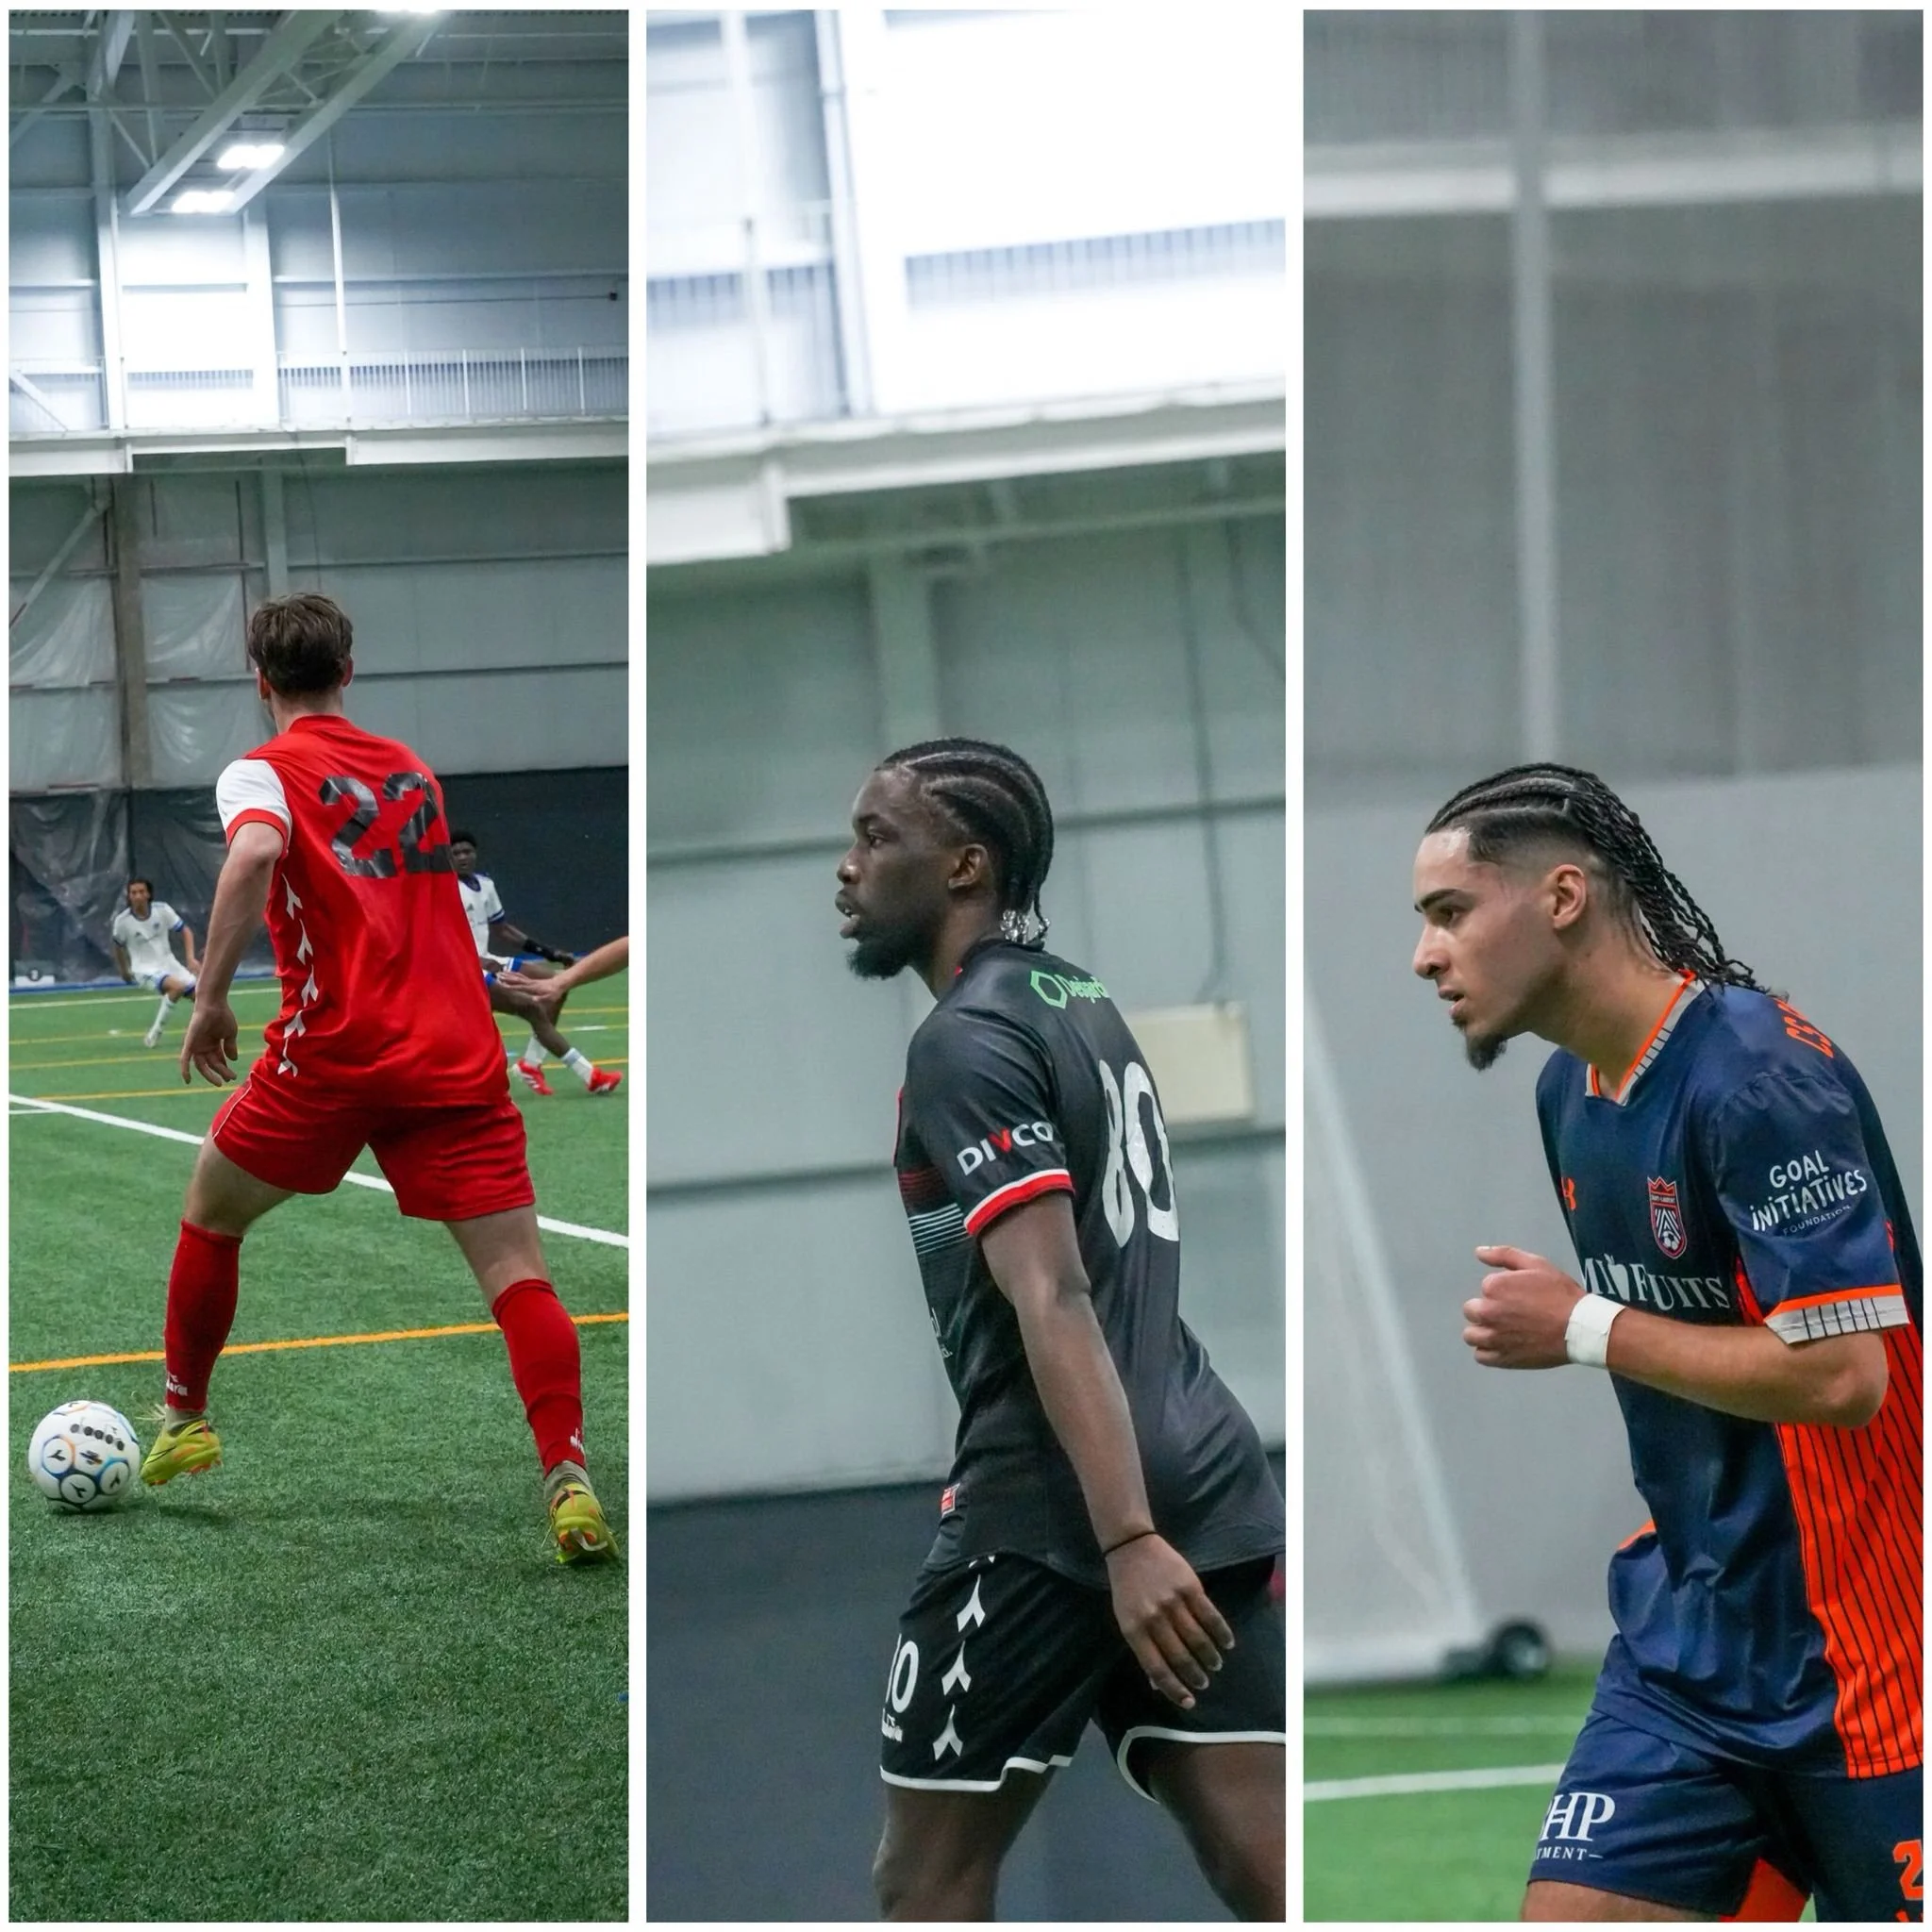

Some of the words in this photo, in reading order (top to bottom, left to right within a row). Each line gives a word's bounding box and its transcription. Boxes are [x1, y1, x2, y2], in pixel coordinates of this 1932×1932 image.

[318, 772, 455, 879] 22
[957, 1121, 1054, 1176] DIVCO
[1099, 1059, 1179, 1248] 80
[1770, 1149, 1830, 1189] GOAL
[885, 1632, 920, 1713] 0
[1540, 1791, 1616, 1842] HP
